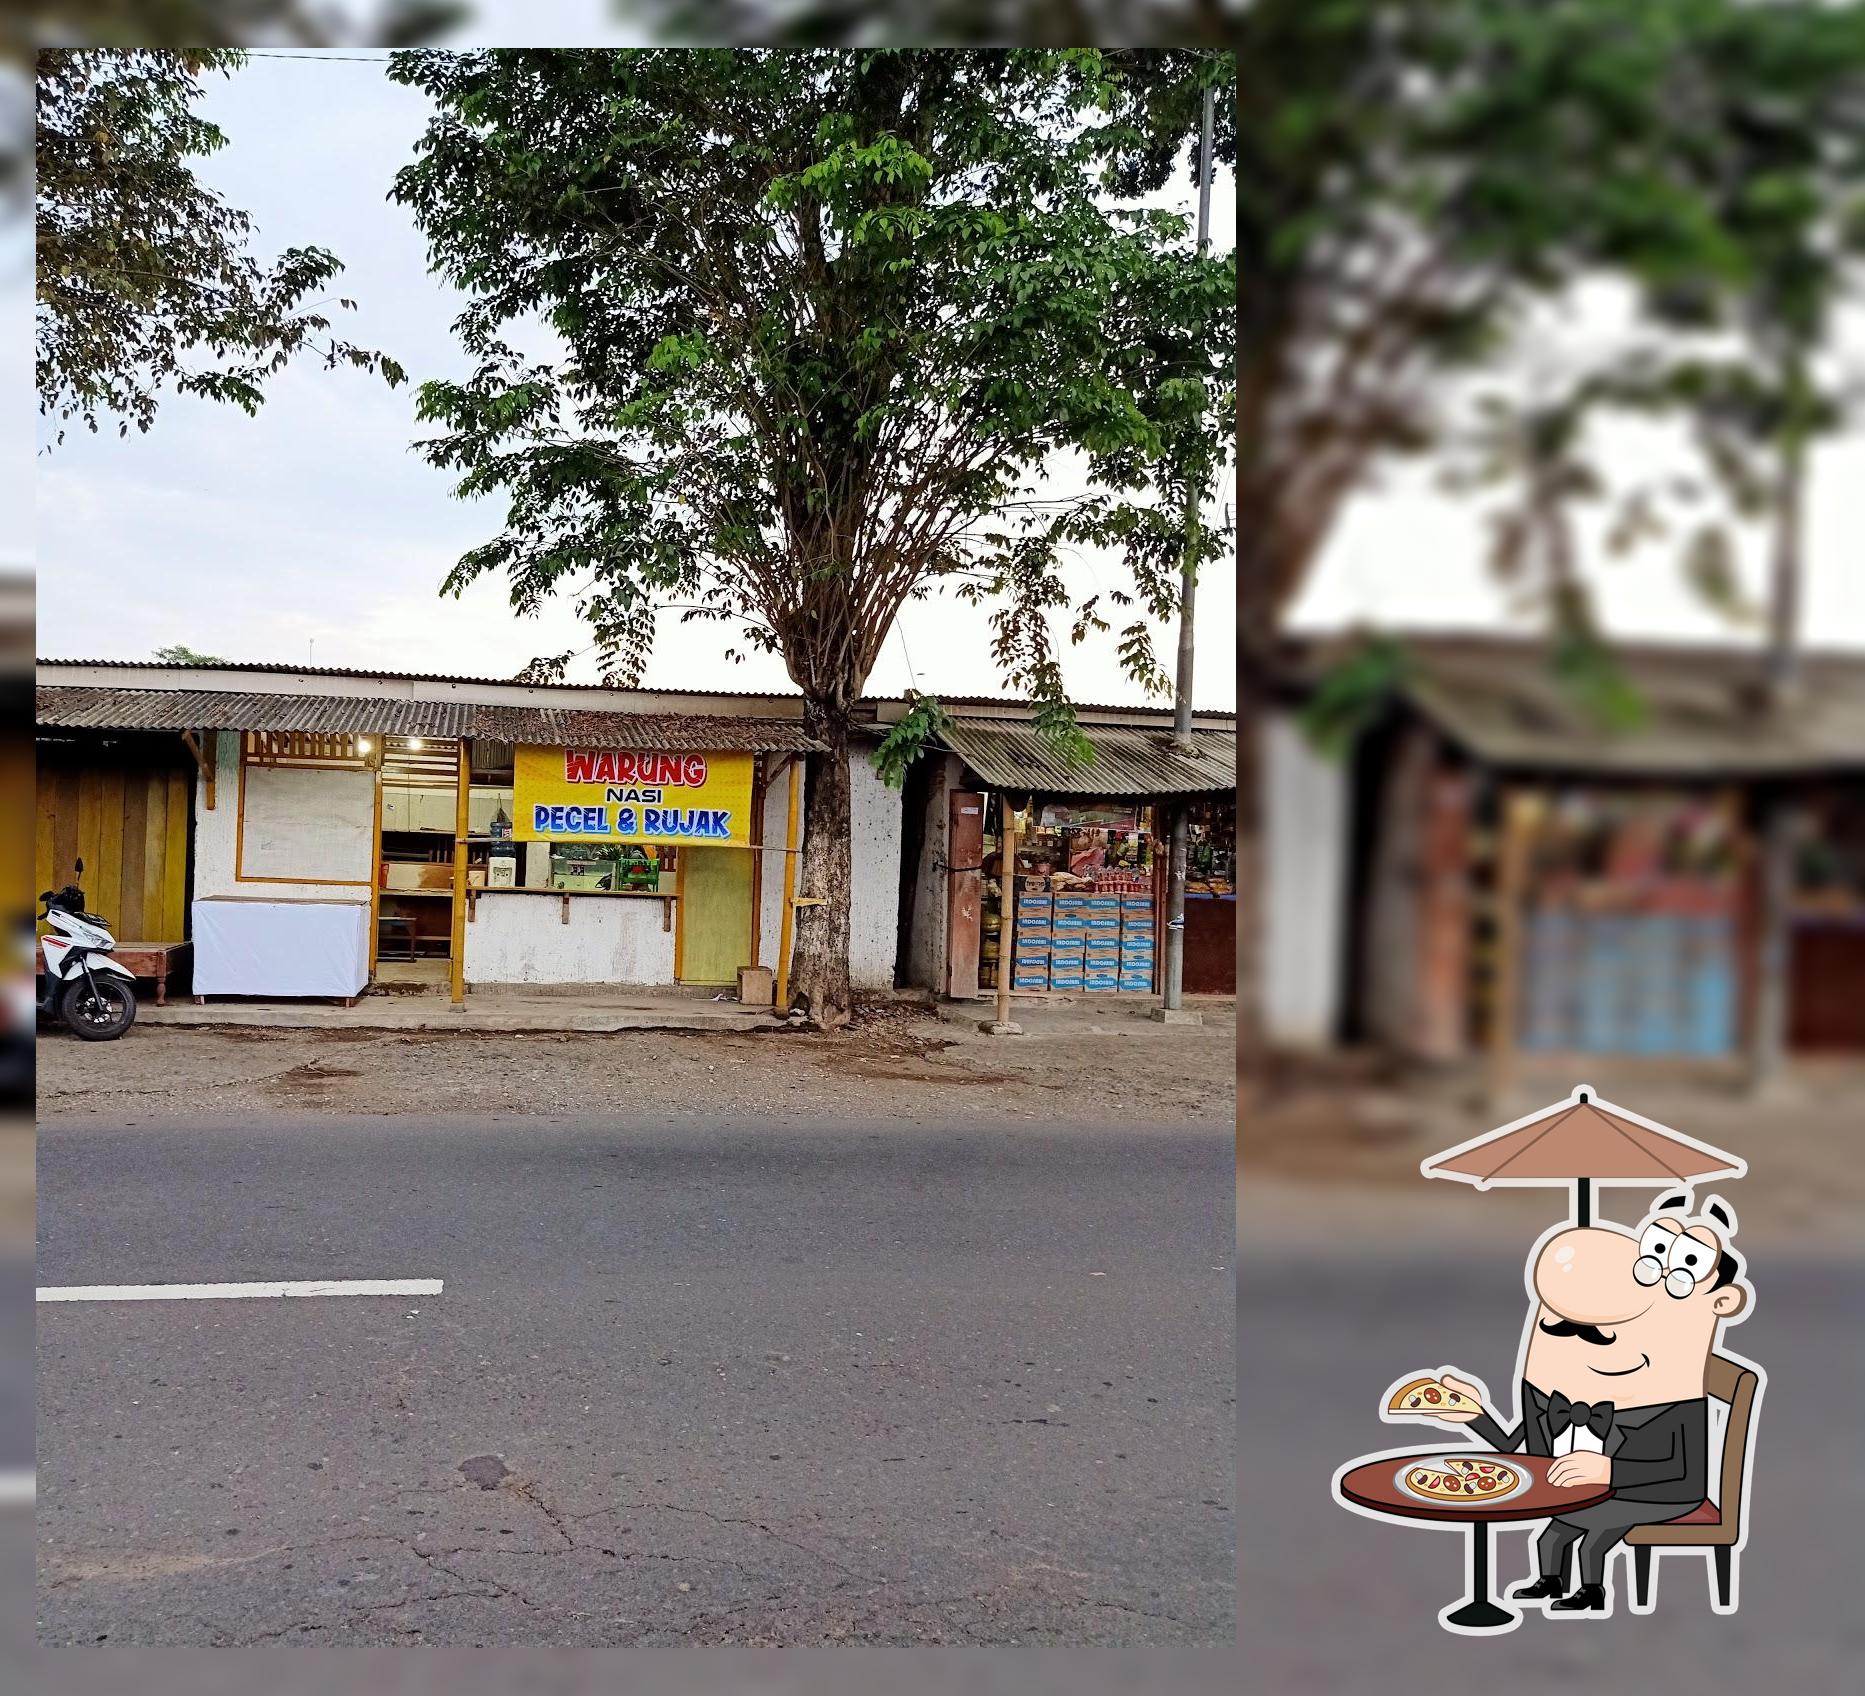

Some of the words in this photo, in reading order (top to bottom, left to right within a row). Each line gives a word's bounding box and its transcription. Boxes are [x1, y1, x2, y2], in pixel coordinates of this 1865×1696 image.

[565, 750, 707, 787] WARUNG
[606, 788, 662, 803] NASI
[534, 805, 611, 832] PECEL
[617, 808, 637, 834] &
[644, 809, 731, 838] RUJAK
